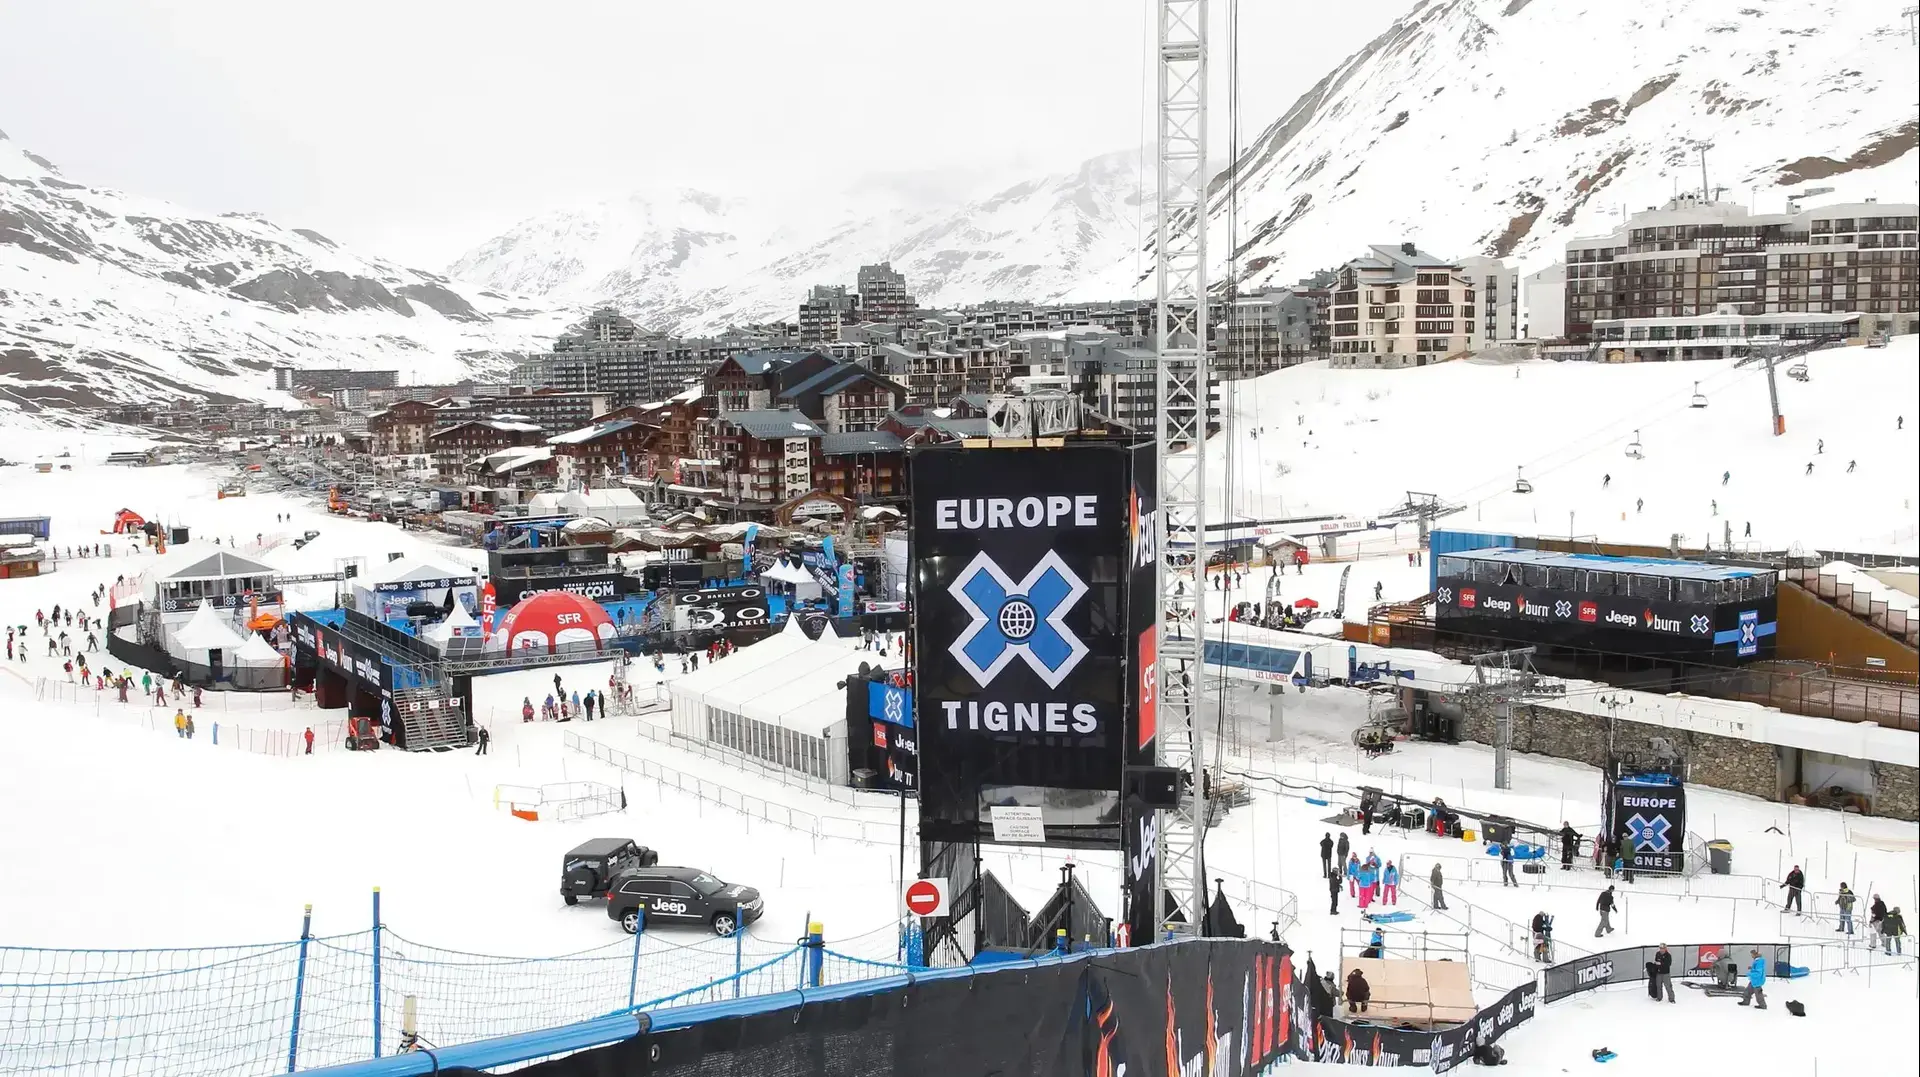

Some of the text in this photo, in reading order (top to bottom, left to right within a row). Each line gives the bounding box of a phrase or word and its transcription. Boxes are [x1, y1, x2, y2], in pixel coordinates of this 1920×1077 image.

[935, 494, 1098, 530] EUROPE
[1138, 497, 1157, 567] bur
[660, 545, 688, 560] burn
[454, 578, 472, 586] Jeep
[1462, 593, 1475, 602] SFR
[1483, 596, 1511, 612] Jeep
[483, 594, 496, 624] SFR
[1525, 600, 1549, 617] burn
[1582, 606, 1596, 616] SFR
[557, 612, 582, 624] SFR
[730, 618, 771, 628] OAKLEY
[1605, 610, 1637, 627] Jeep
[1654, 614, 1680, 633] burn
[1144, 663, 1156, 704] SF
[941, 701, 1098, 734] TIGNES
[1623, 796, 1677, 808] EUROPE
[1133, 815, 1156, 882] Jee
[1634, 856, 1673, 867] GNES
[651, 898, 687, 915] Jeep
[1577, 960, 1614, 985] TIGNES
[1687, 969, 1712, 977] QUIKS
[1518, 991, 1537, 1013] Jeep
[1497, 1003, 1514, 1026] Jeep
[1477, 1017, 1494, 1038] Jeep
